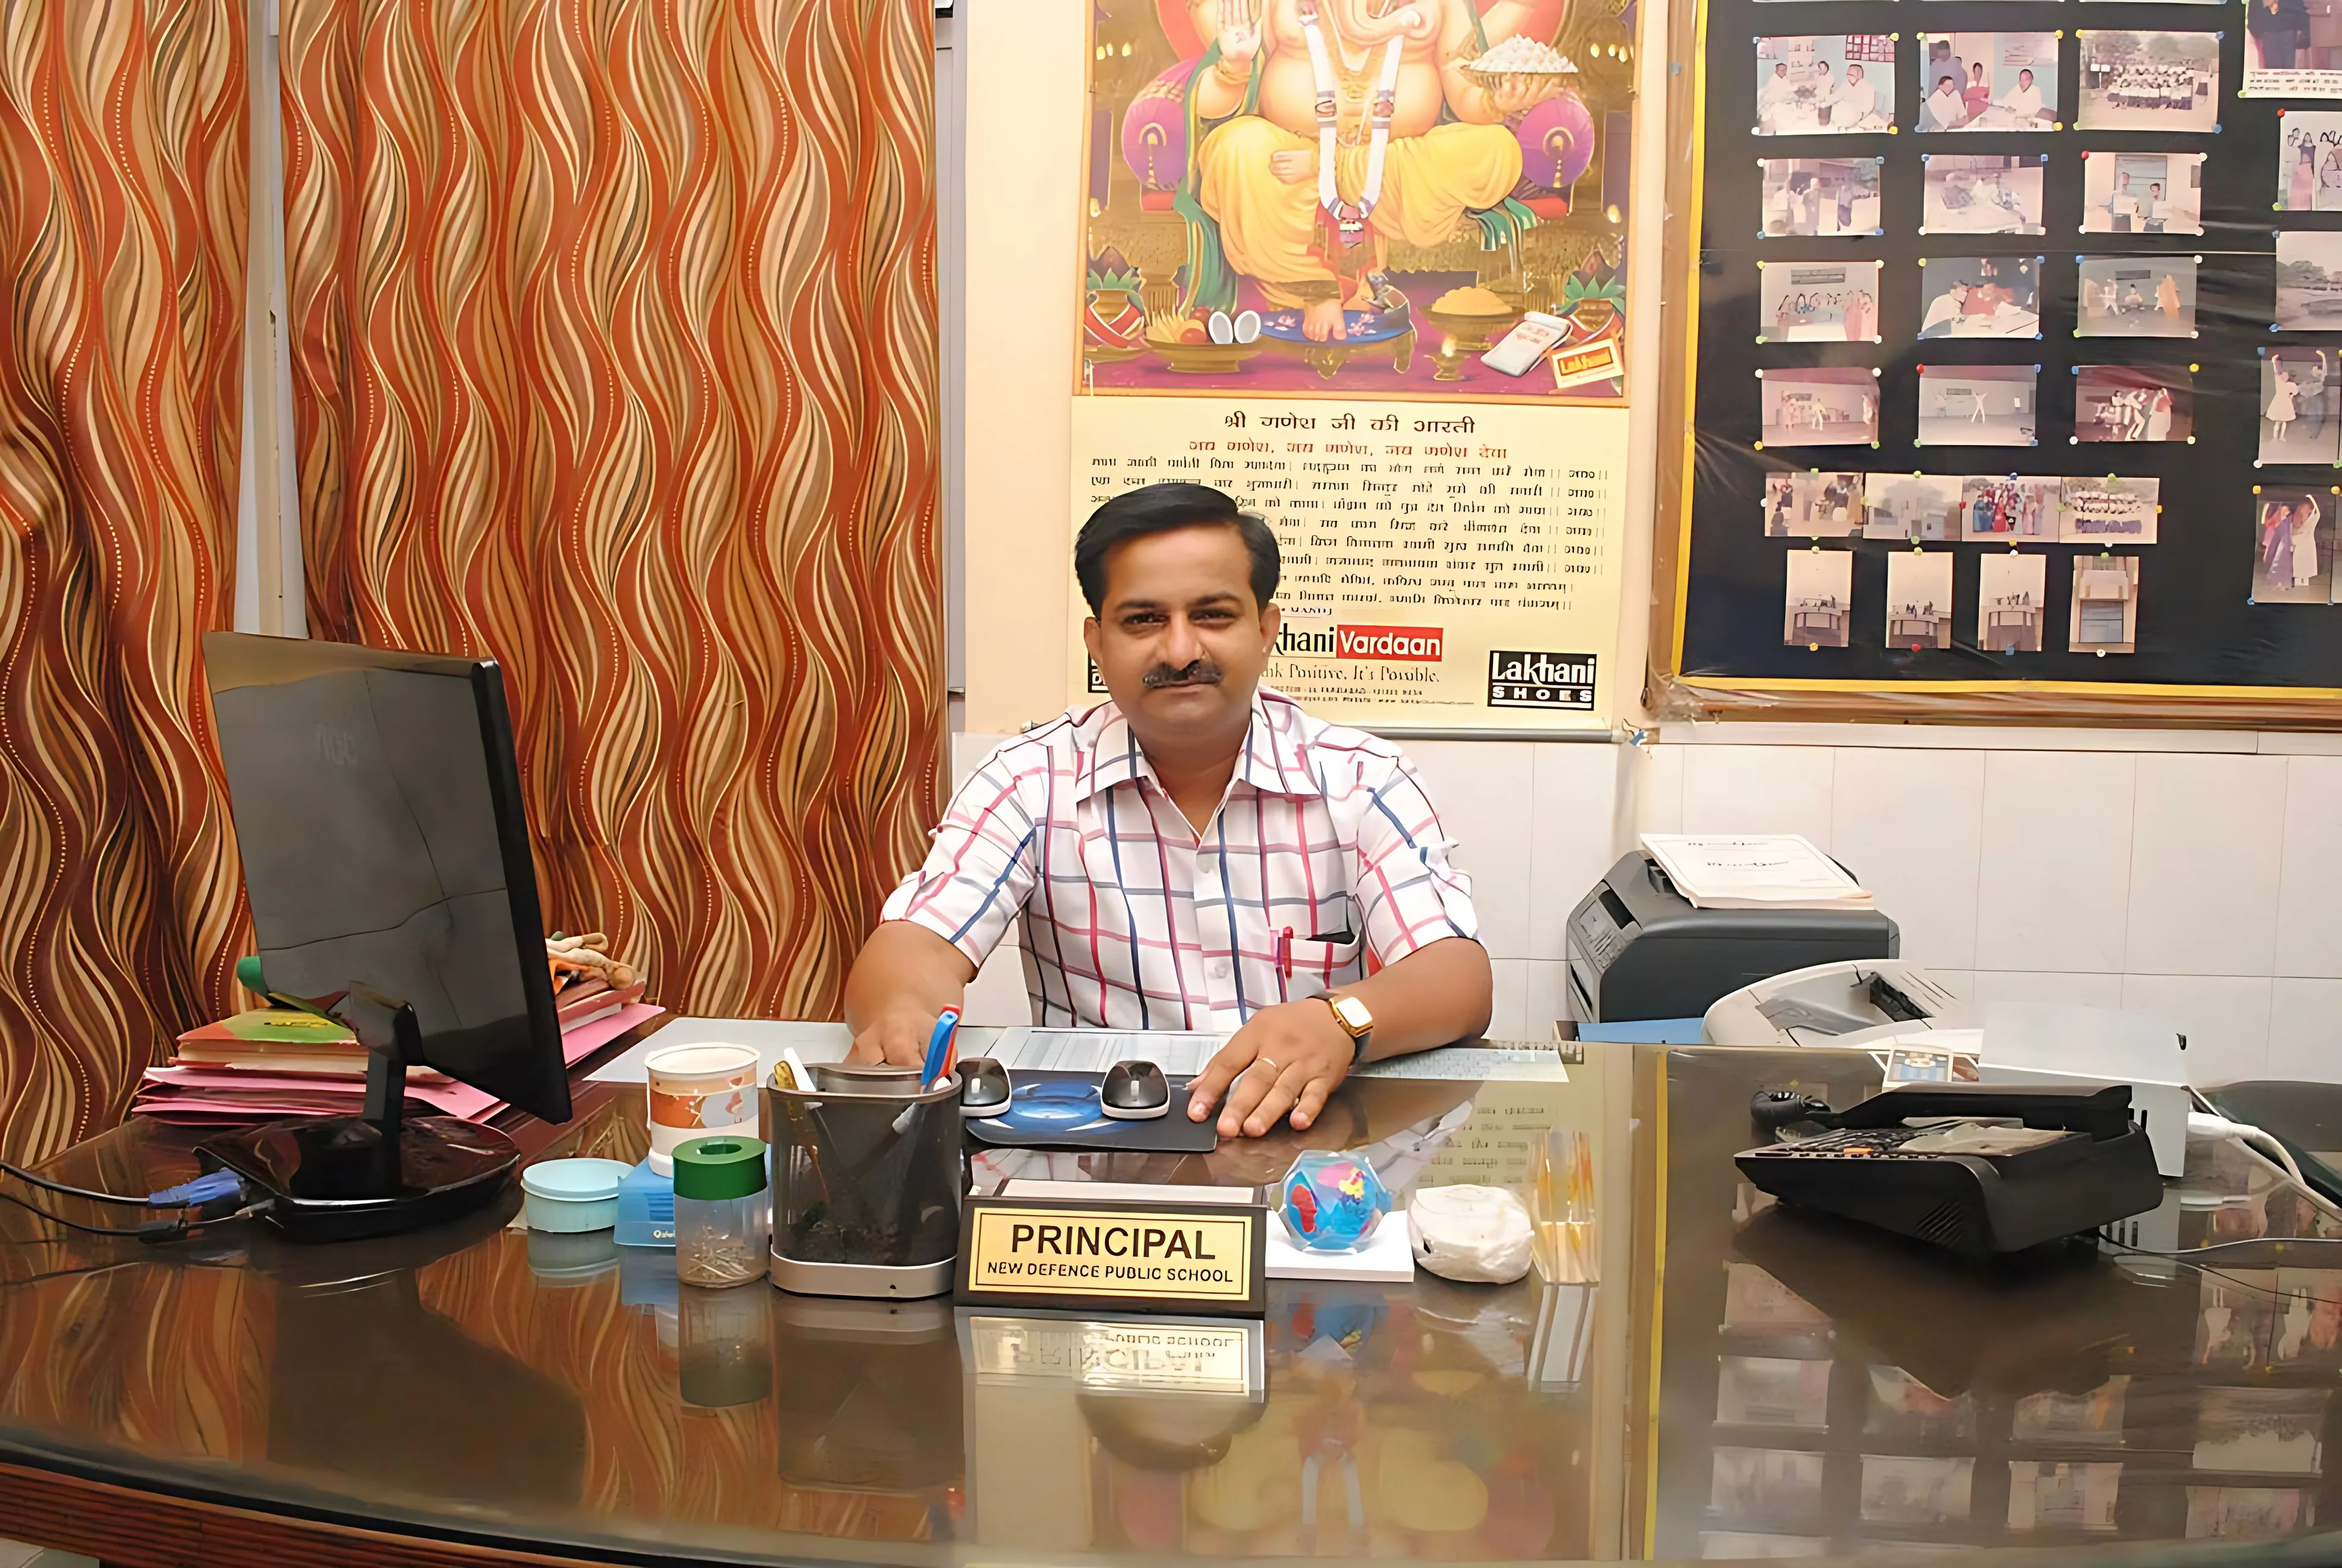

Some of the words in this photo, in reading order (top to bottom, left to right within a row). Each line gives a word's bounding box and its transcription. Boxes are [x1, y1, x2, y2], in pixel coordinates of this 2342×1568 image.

[1259, 412, 1316, 429] गणेश
[1331, 413, 1355, 429] जी
[1370, 414, 1398, 431] की
[1414, 416, 1475, 433] आरती
[1339, 630, 1441, 656] Vardaan
[1492, 653, 1595, 685] Lakhani
[1492, 686, 1592, 702] SHOES
[1011, 1224, 1216, 1260] PRINCIPAL
[987, 1262, 1023, 1275] NEW
[1027, 1263, 1099, 1278] DEFENCE
[1105, 1266, 1161, 1280] PUBLIC
[1167, 1269, 1233, 1282] SCHOOL
